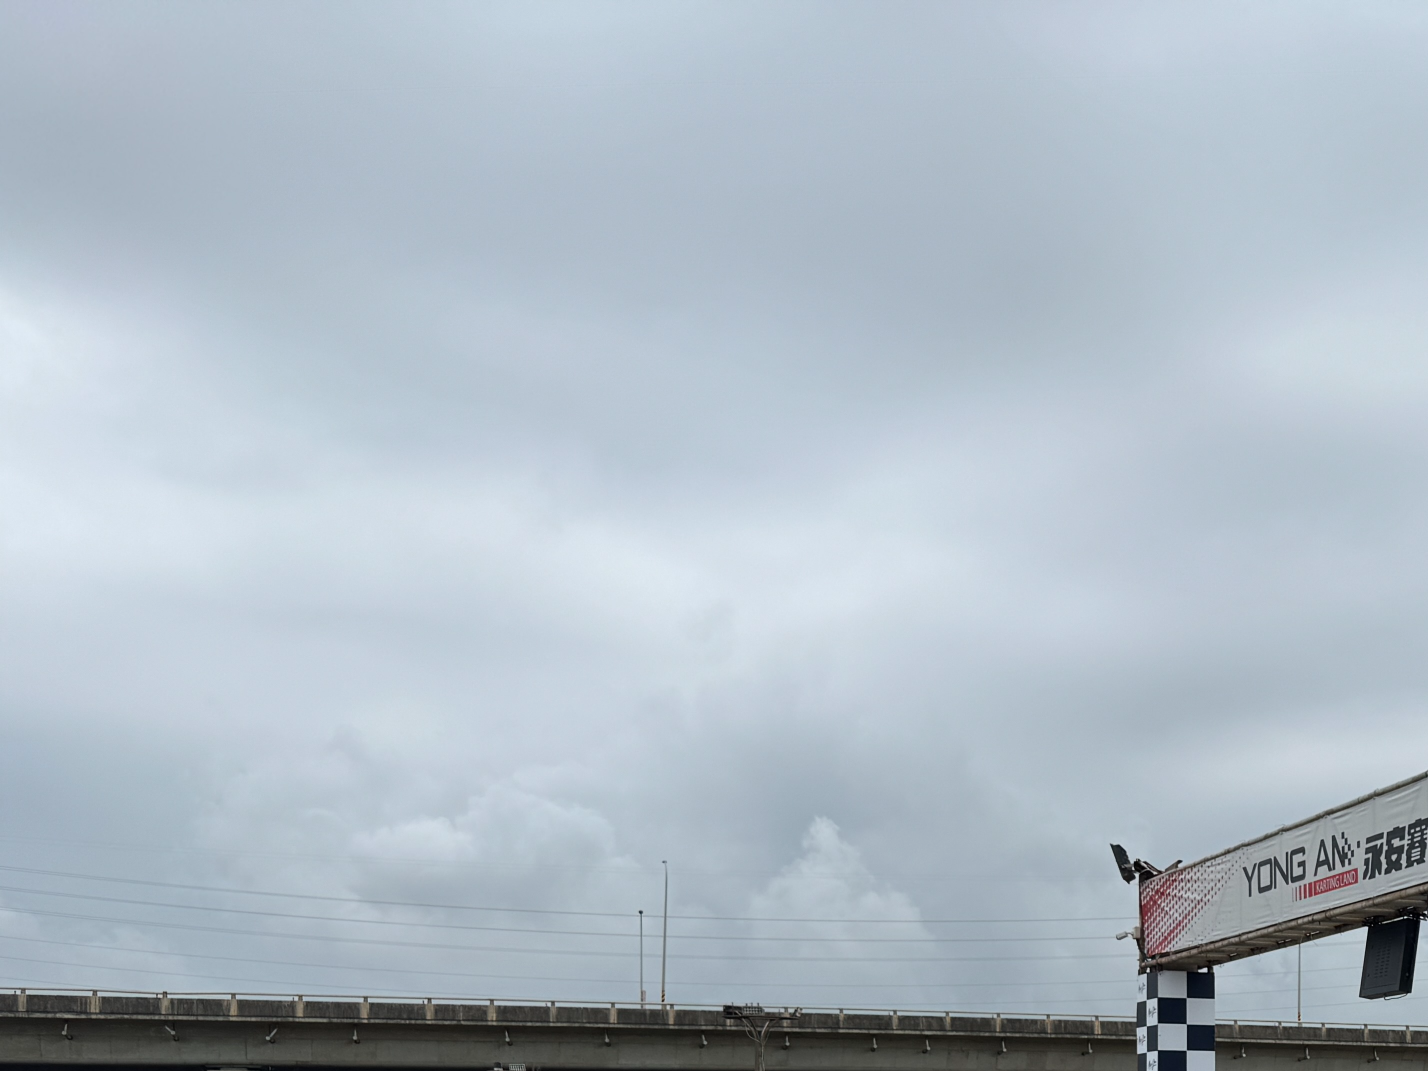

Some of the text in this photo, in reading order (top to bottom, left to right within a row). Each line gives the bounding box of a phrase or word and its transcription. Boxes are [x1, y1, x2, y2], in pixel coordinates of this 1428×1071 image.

[1242, 846, 1306, 898] YONG
[1315, 870, 1357, 893] KARTING LAND
